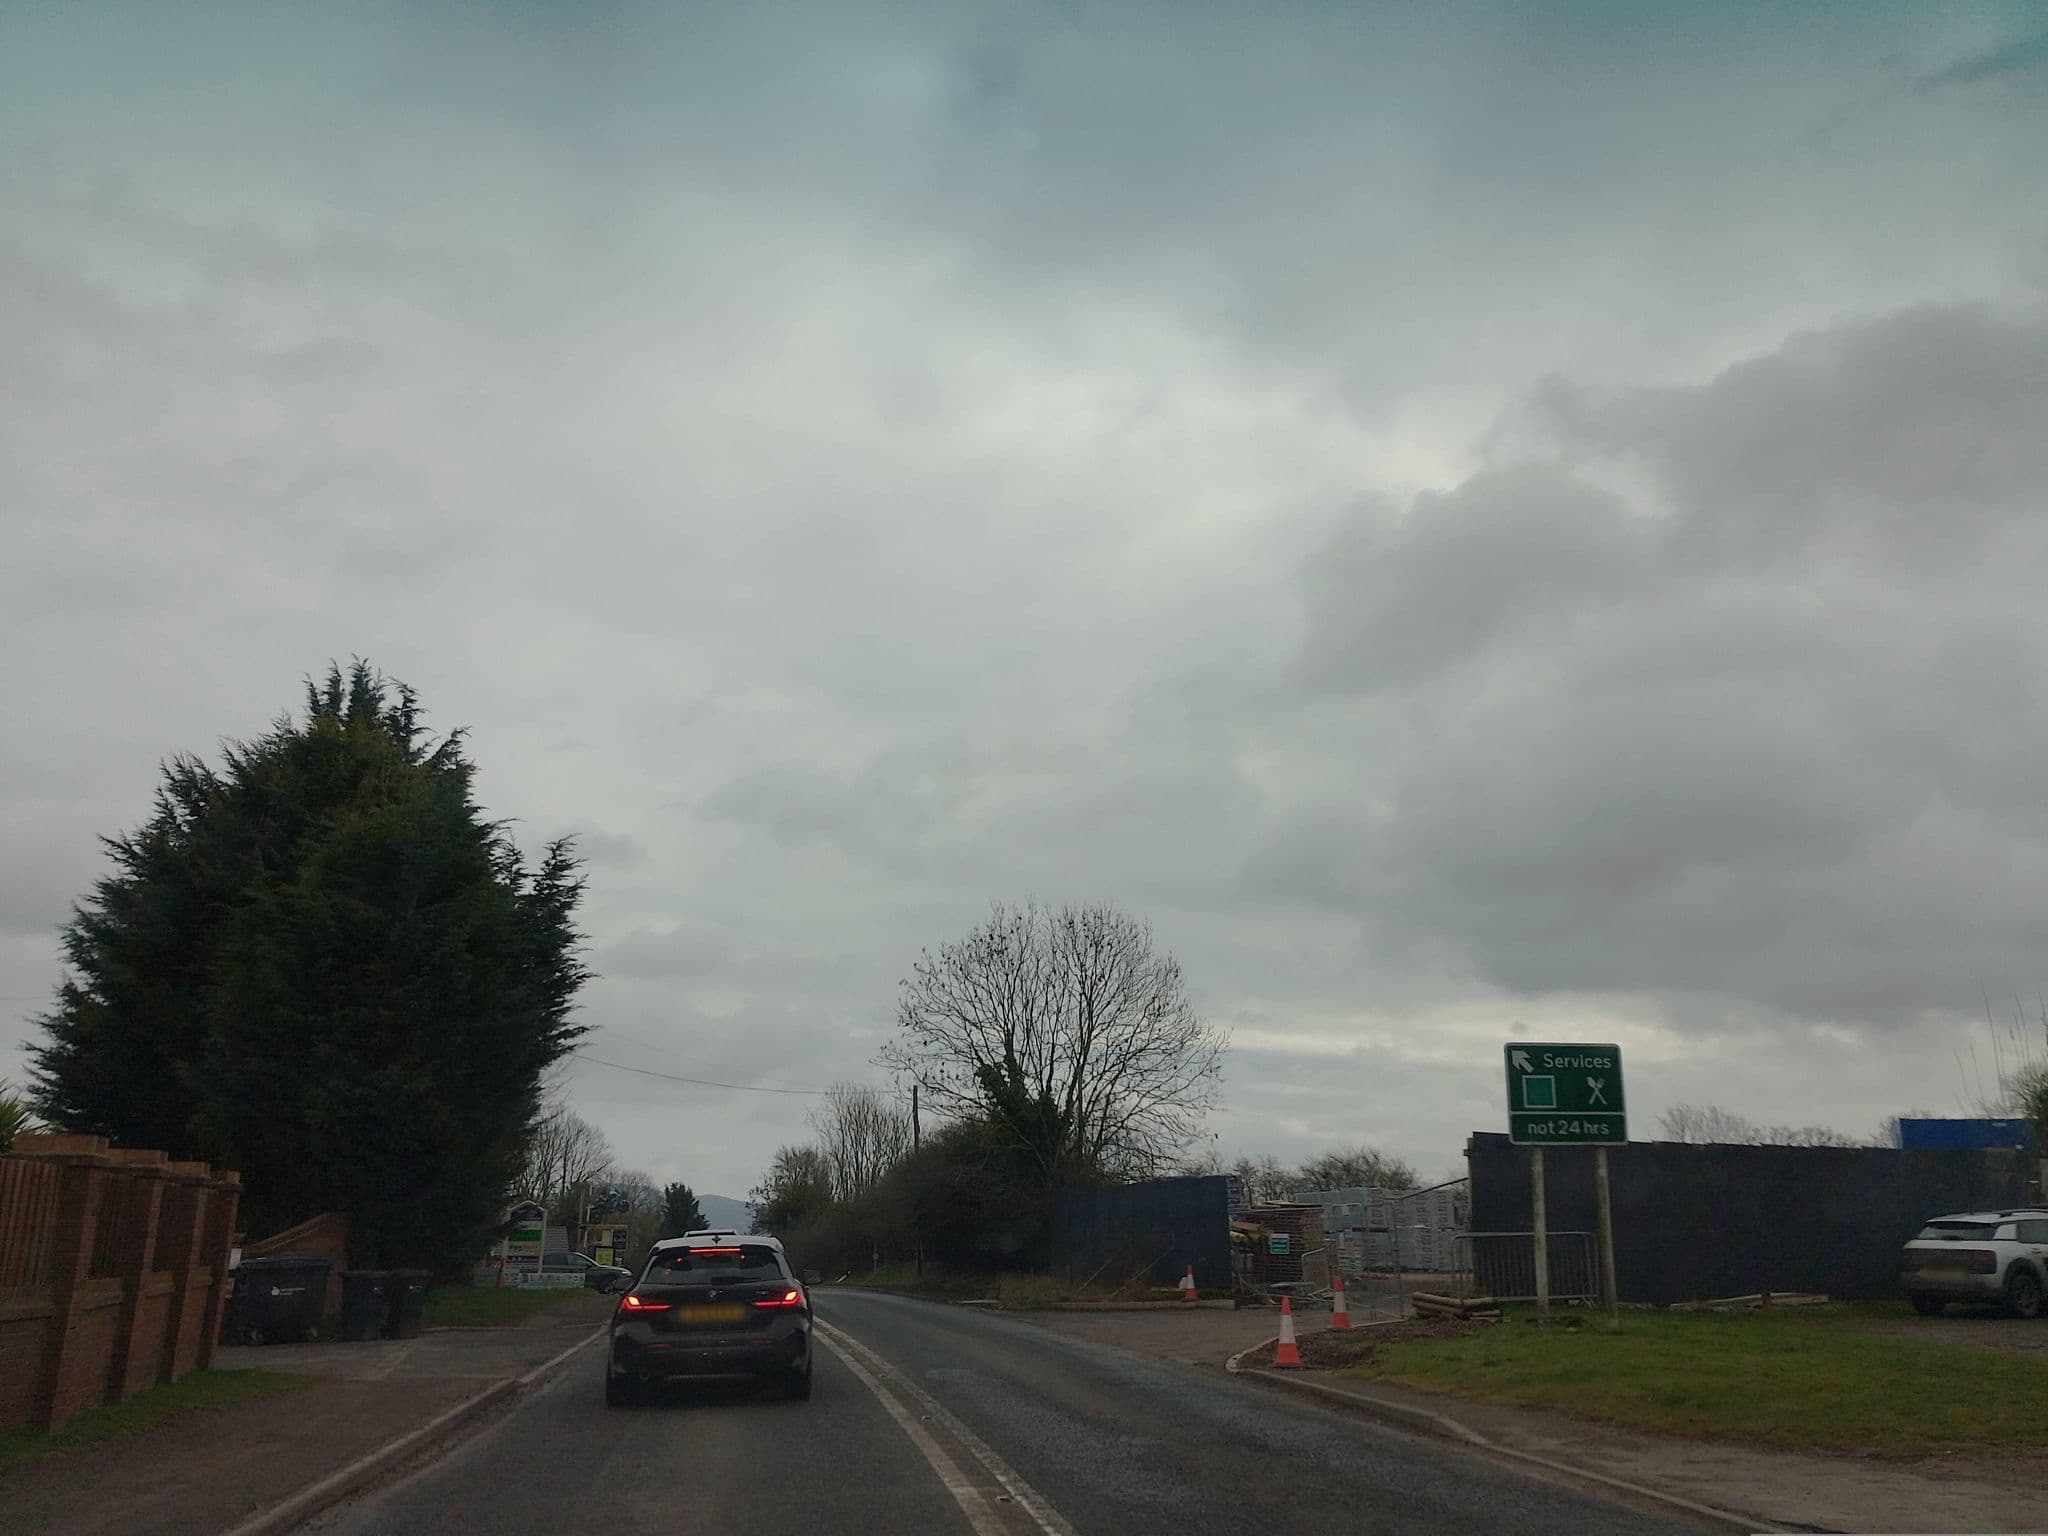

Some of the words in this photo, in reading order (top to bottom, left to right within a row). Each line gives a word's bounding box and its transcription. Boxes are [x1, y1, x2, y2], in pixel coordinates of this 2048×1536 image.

[1543, 1053, 1611, 1068] Services
[1528, 1121, 1555, 1134] not
[1558, 1120, 1580, 1134] 24
[1584, 1121, 1609, 1134] hrs
